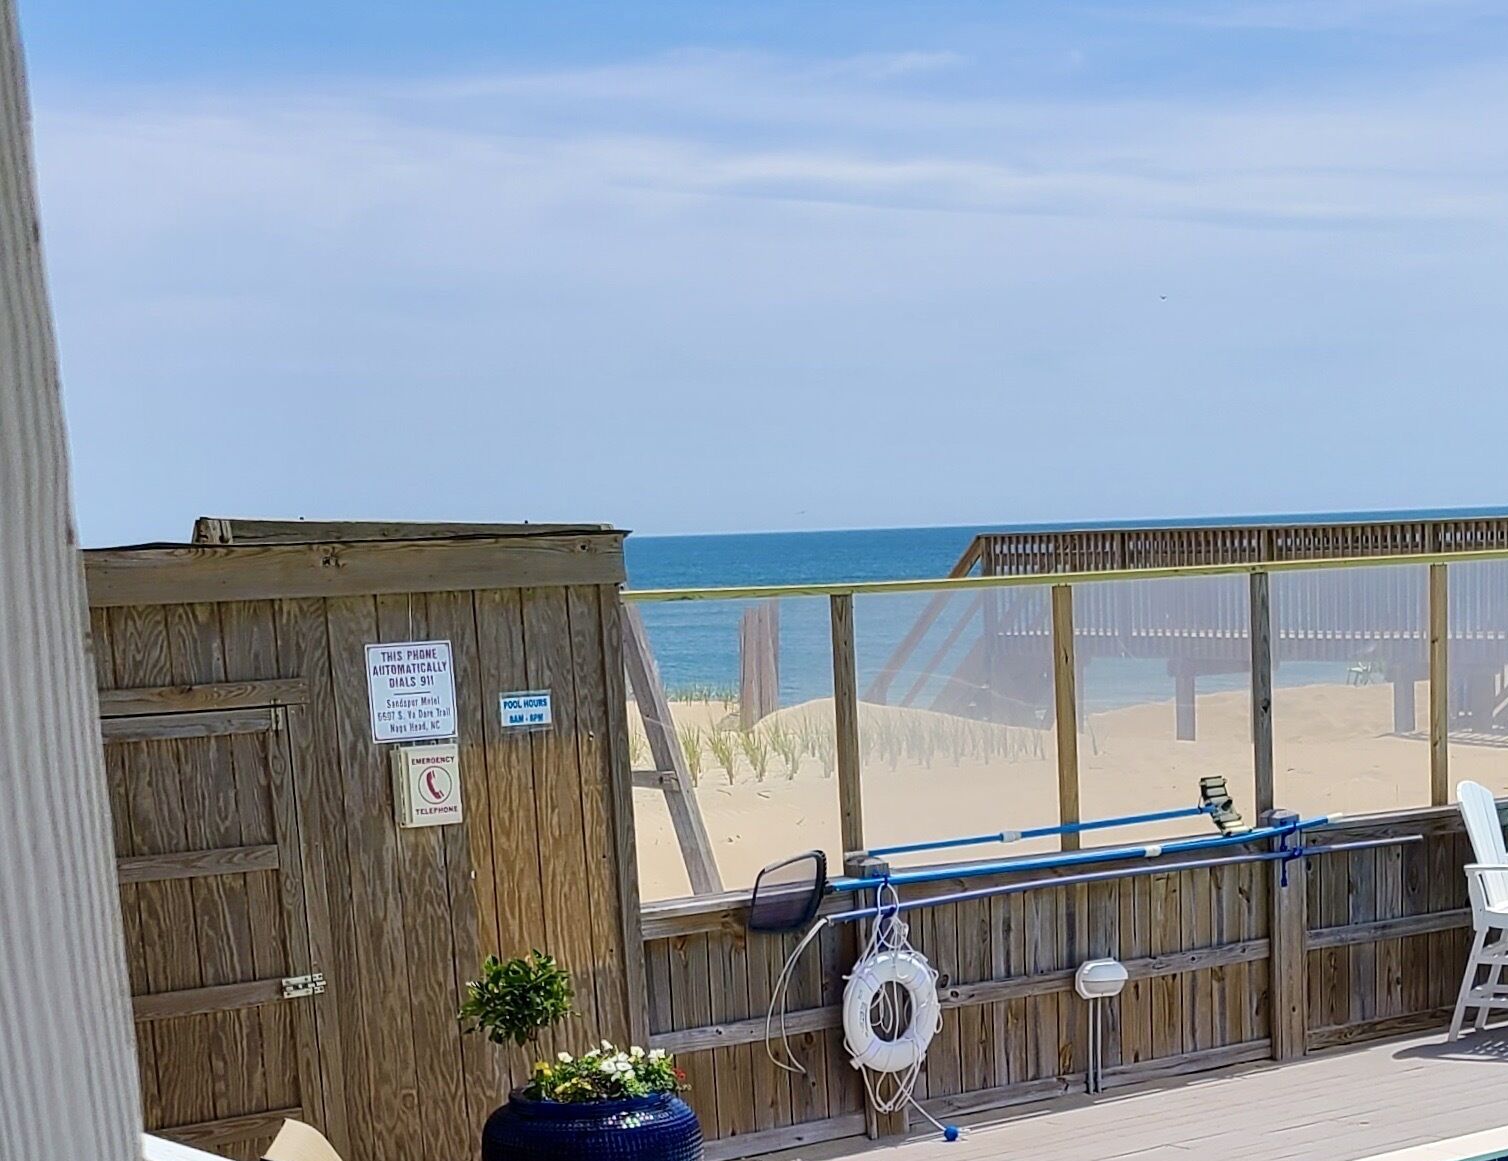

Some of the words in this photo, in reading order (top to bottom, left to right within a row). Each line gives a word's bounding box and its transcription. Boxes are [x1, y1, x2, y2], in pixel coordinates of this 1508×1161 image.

[381, 650, 403, 662] THIS
[407, 648, 437, 661] PHONE
[373, 661, 447, 676] AUTOMATICALLY
[389, 676, 416, 688] DIALS
[420, 675, 434, 686] 911
[420, 696, 440, 706] Motel
[503, 700, 522, 710] POOL
[523, 698, 547, 708] HOURS
[418, 708, 434, 718] Dare
[436, 707, 450, 717] Trail
[431, 720, 441, 730] NC
[411, 756, 455, 766] EMERGENCY
[415, 805, 458, 816] TELEPHONE
